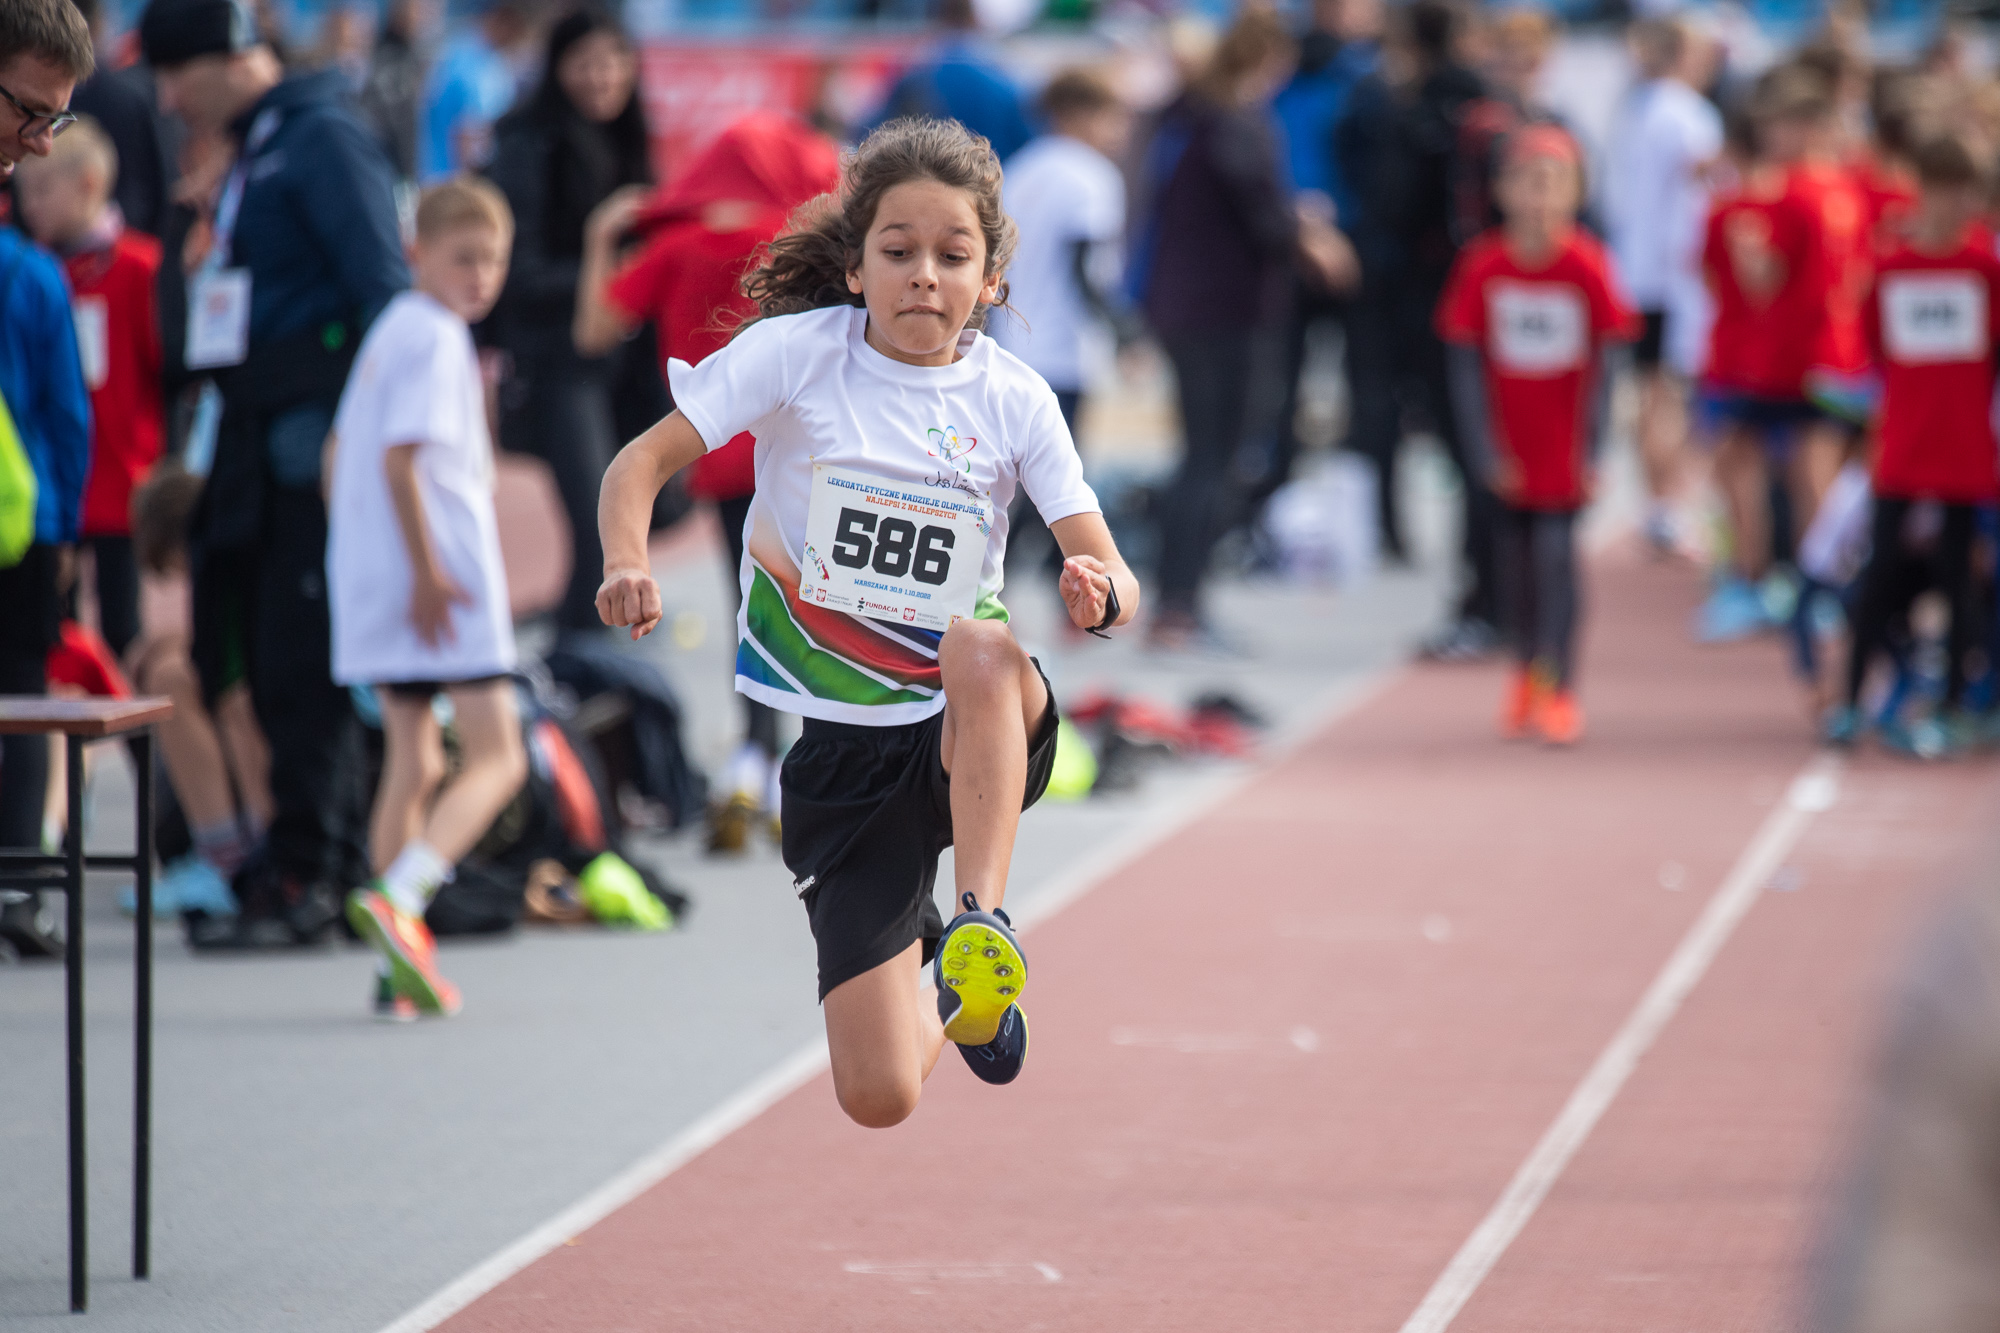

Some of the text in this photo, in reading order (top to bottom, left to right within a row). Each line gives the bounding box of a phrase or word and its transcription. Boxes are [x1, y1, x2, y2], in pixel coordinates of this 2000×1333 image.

[827, 476, 985, 516] LEKKOATLETYCZNE NADZIEJE OLIMPIJSKIE
[865, 495, 957, 520] NAJLEPSI Z NAJLEPSZYCH
[831, 506, 956, 586] 586
[854, 578, 888, 592] WARSZAWA
[865, 601, 898, 613] FUNDACJA
